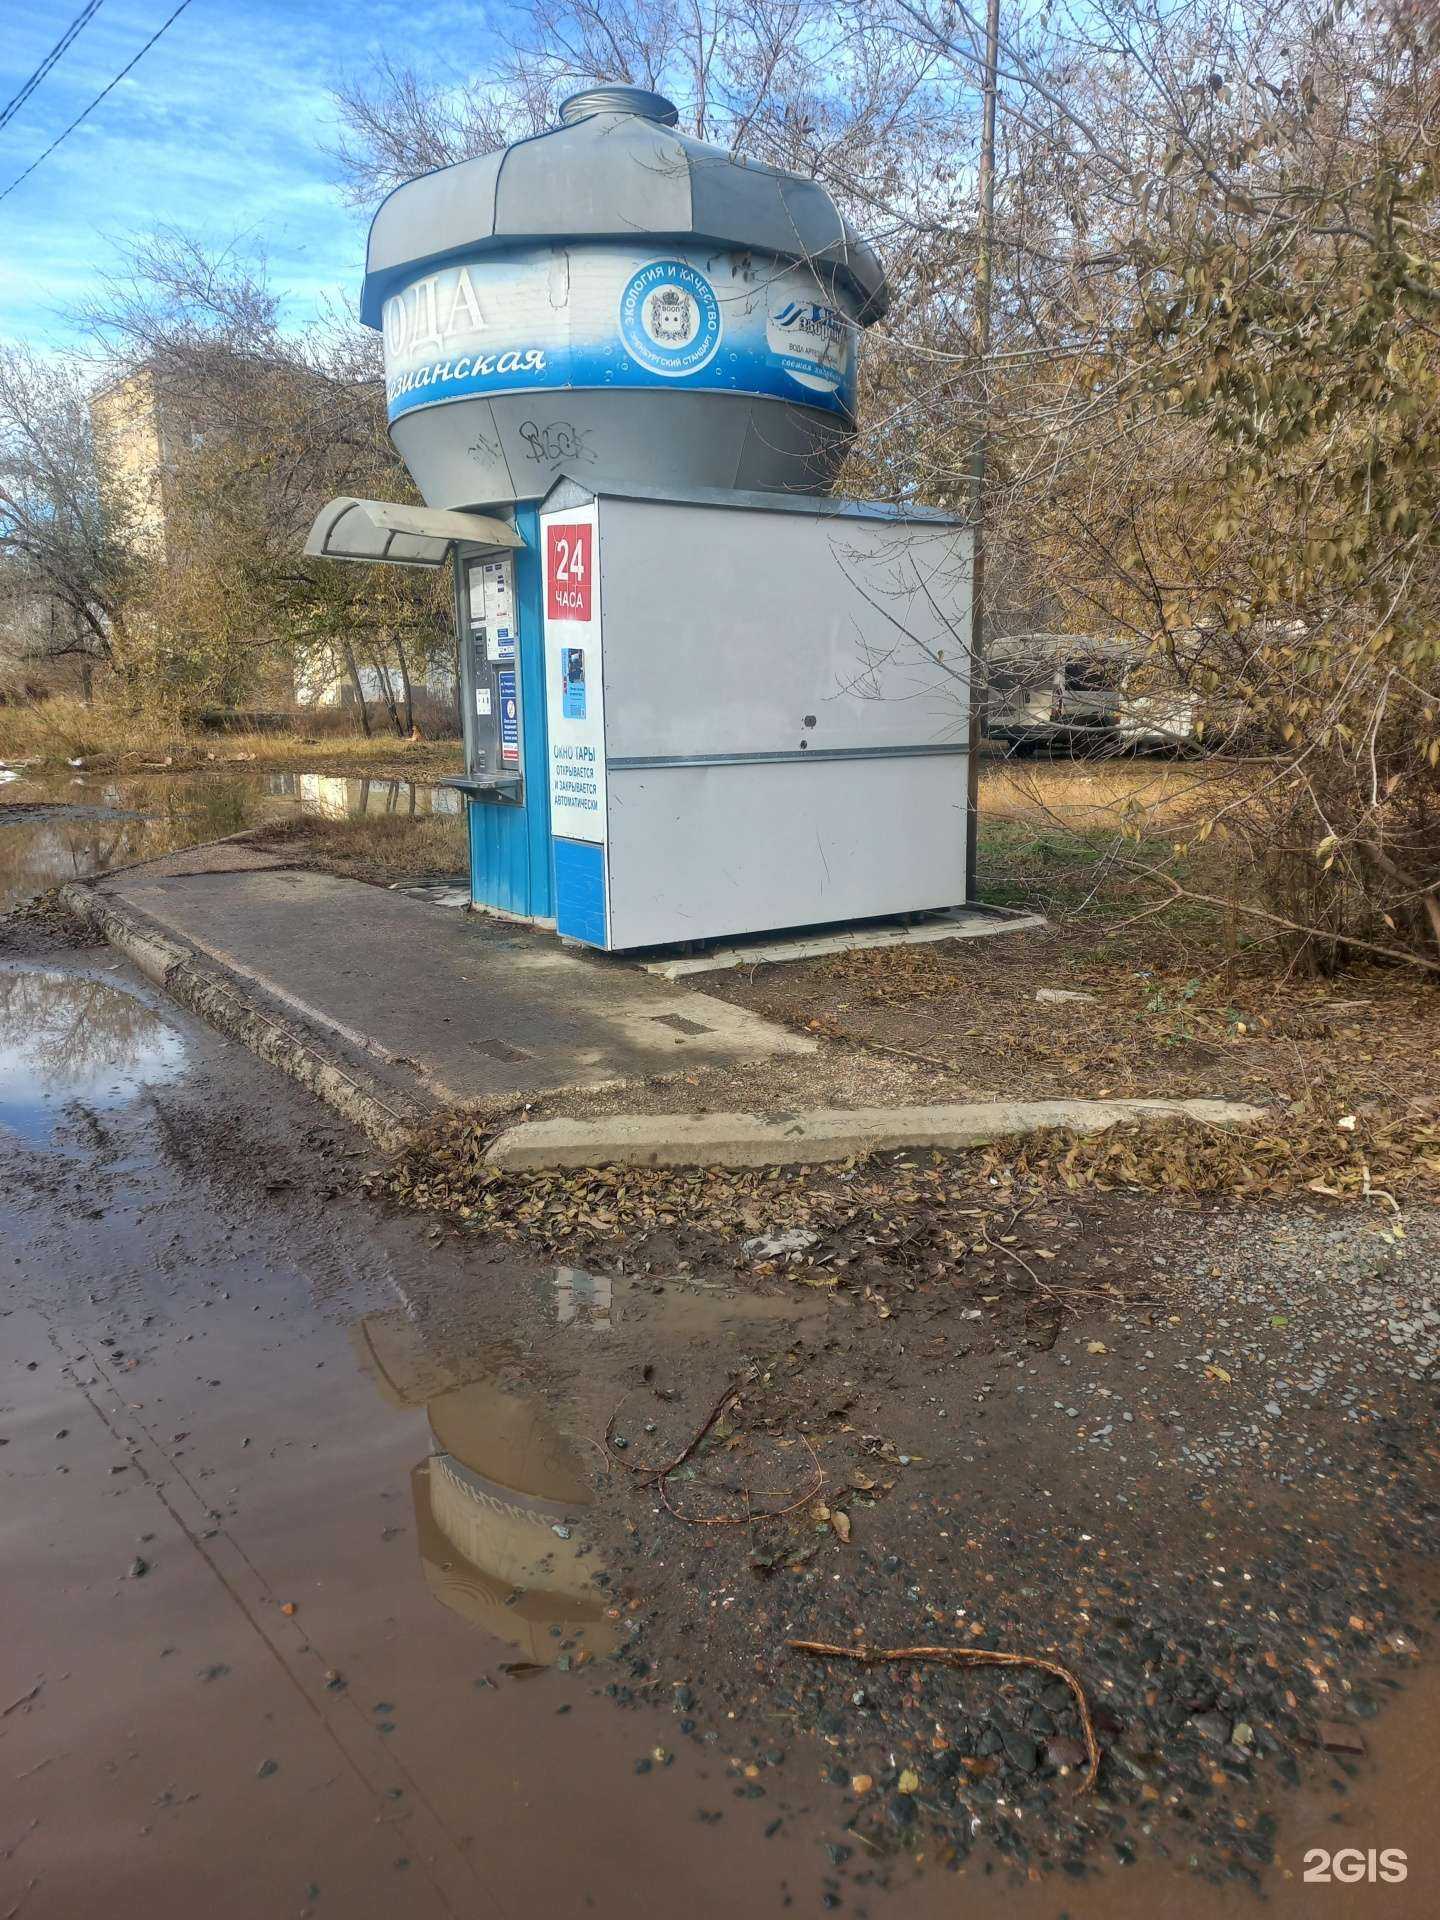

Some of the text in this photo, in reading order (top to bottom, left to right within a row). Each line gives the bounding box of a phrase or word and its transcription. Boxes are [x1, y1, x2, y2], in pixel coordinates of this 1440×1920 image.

[624, 265, 717, 331] ЭКОЛОГИЯ И КАЧЕСТВО
[681, 334, 713, 366] СТАНДАРТ
[556, 538, 585, 582] 24
[555, 590, 584, 609] ЧАСА
[554, 744, 596, 762] ОКНО ТАРЫ
[556, 764, 594, 778] ОТКРЫВАЕТСЯ
[559, 780, 597, 795] ЗАКРЫВАЕТСЯ
[555, 795, 598, 811] АВТОМАТИЧЕСКИ
